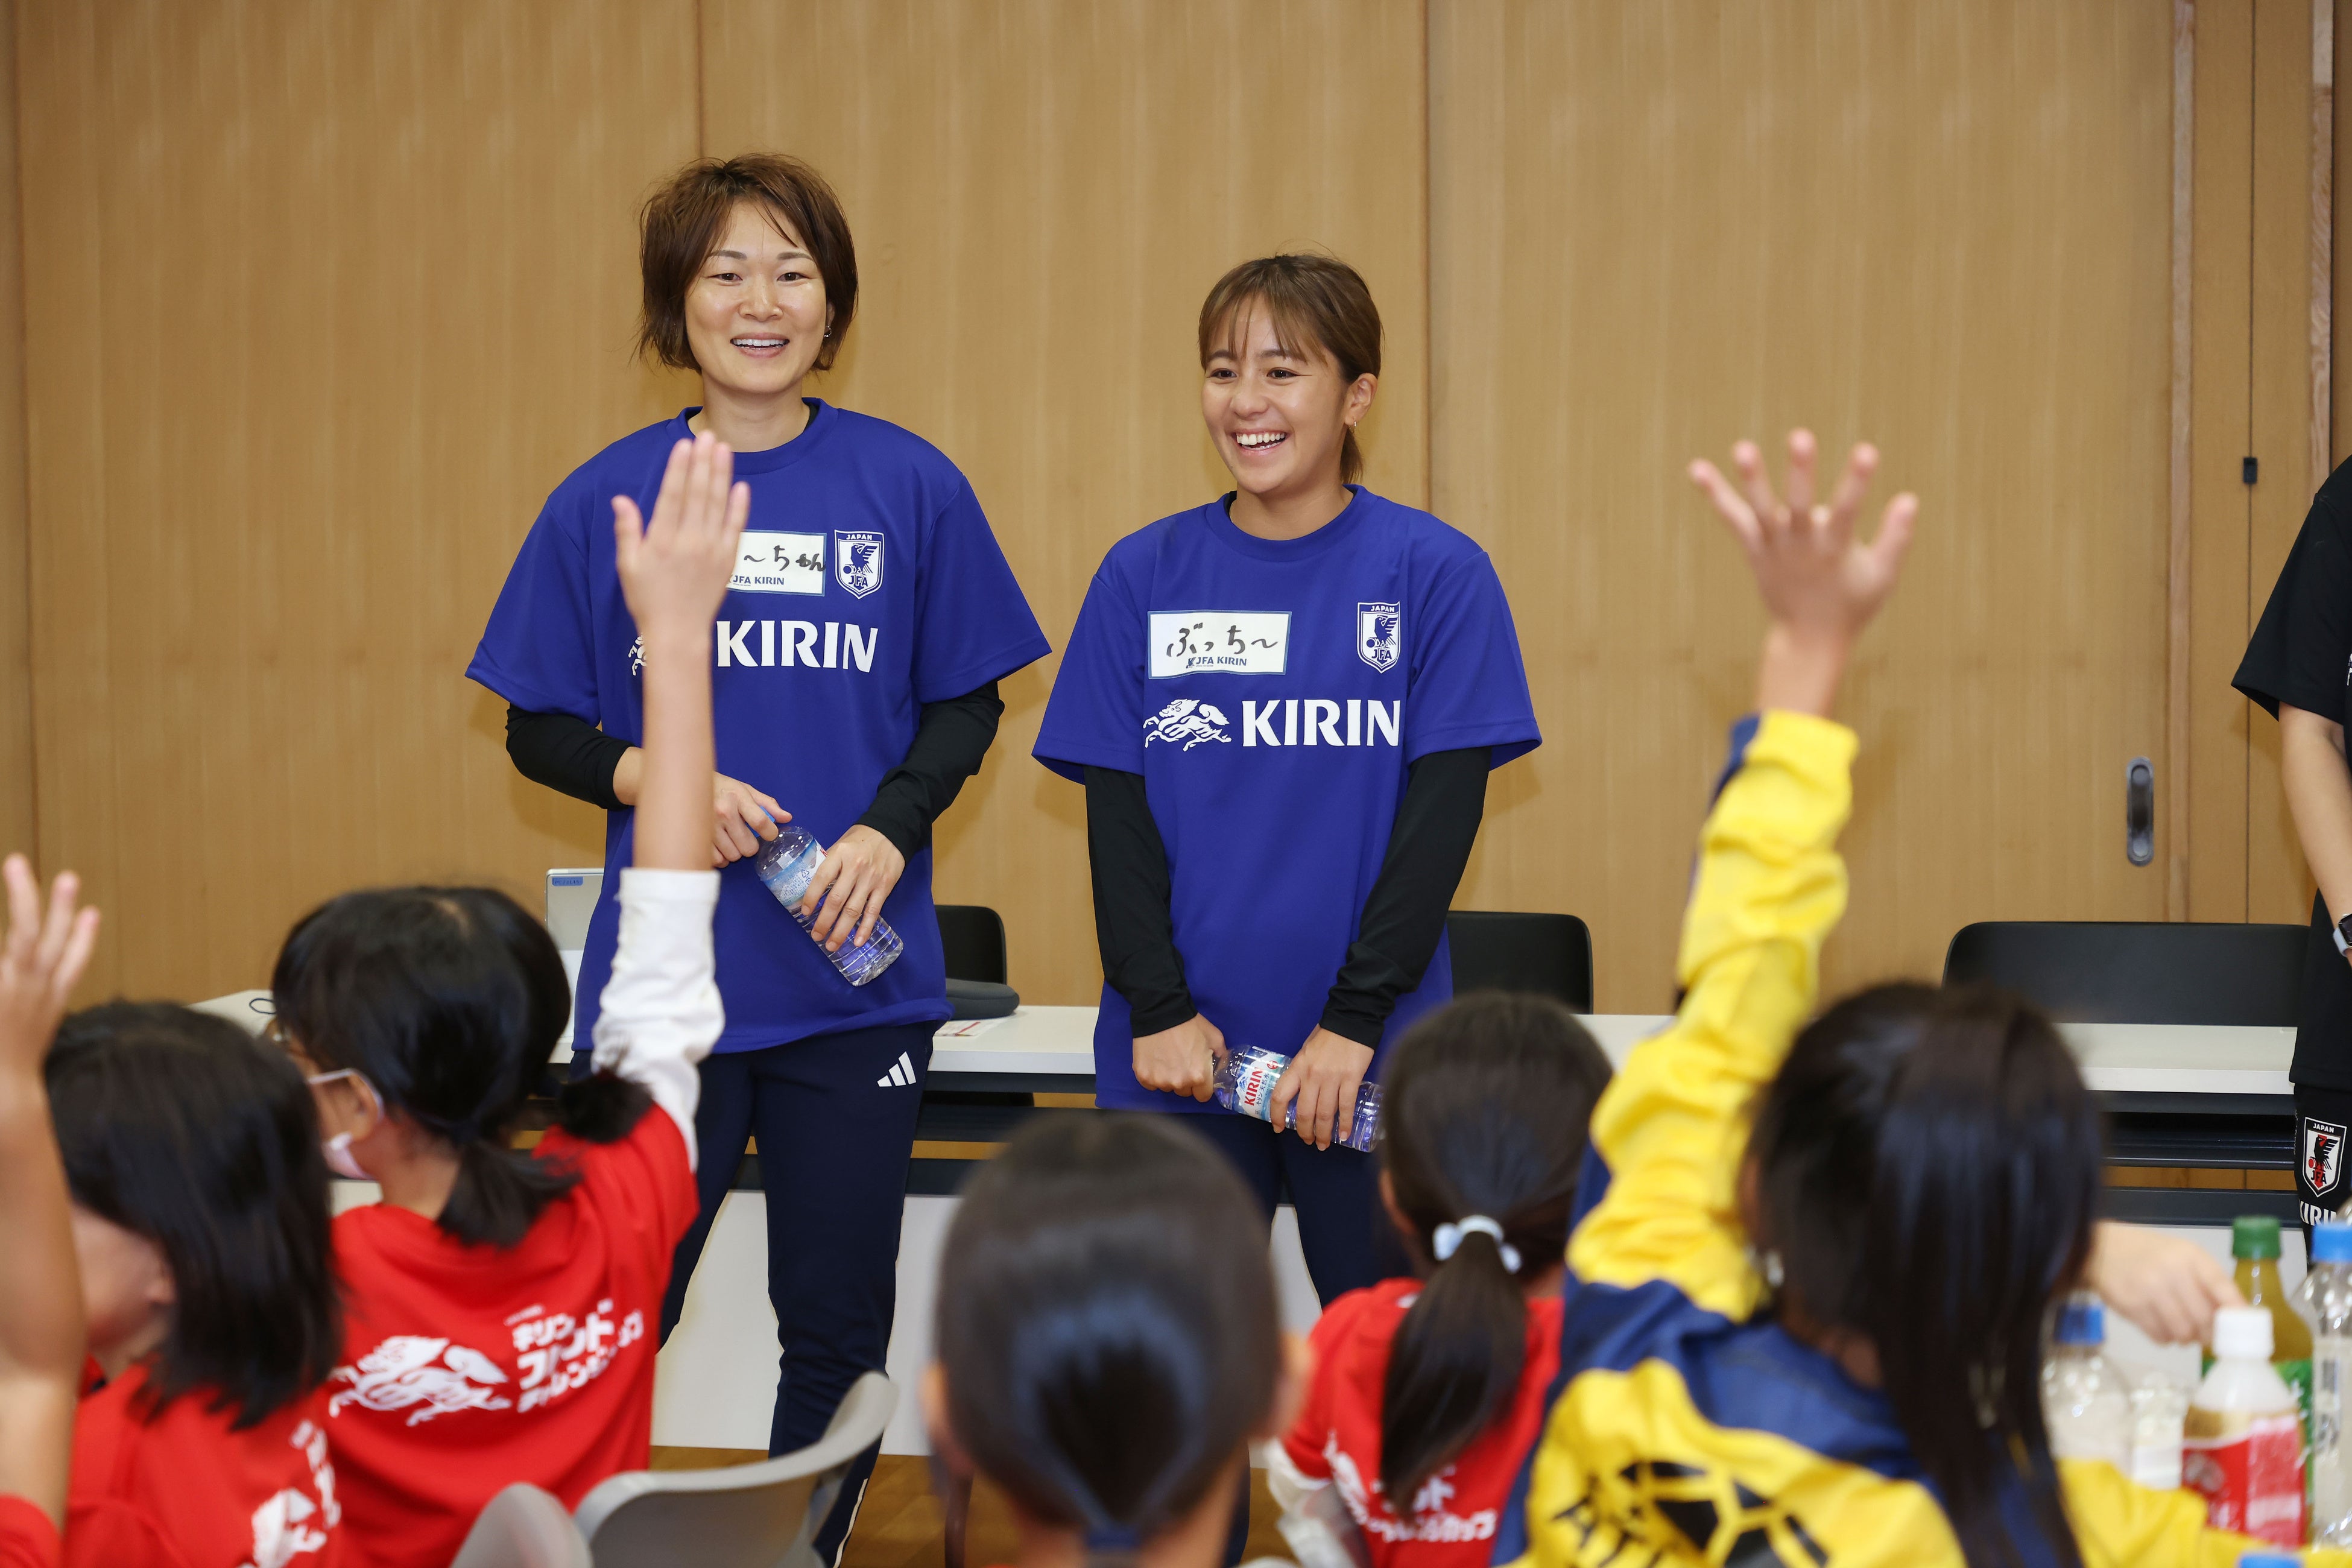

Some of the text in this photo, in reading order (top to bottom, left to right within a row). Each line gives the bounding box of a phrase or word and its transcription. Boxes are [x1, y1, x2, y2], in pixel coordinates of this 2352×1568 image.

[733, 575, 751, 584] JFA
[754, 577, 785, 585] KIRIN
[848, 575, 868, 587] JFA
[716, 620, 879, 673] KIRIN
[1371, 649, 1393, 660] JFA
[1196, 656, 1247, 666] JFA KIRIN
[1242, 699, 1401, 747] KIRIN
[1244, 1067, 1263, 1107] KIRIN
[2313, 1123, 2335, 1134] JAPAN
[2310, 1170, 2327, 1184] JFA
